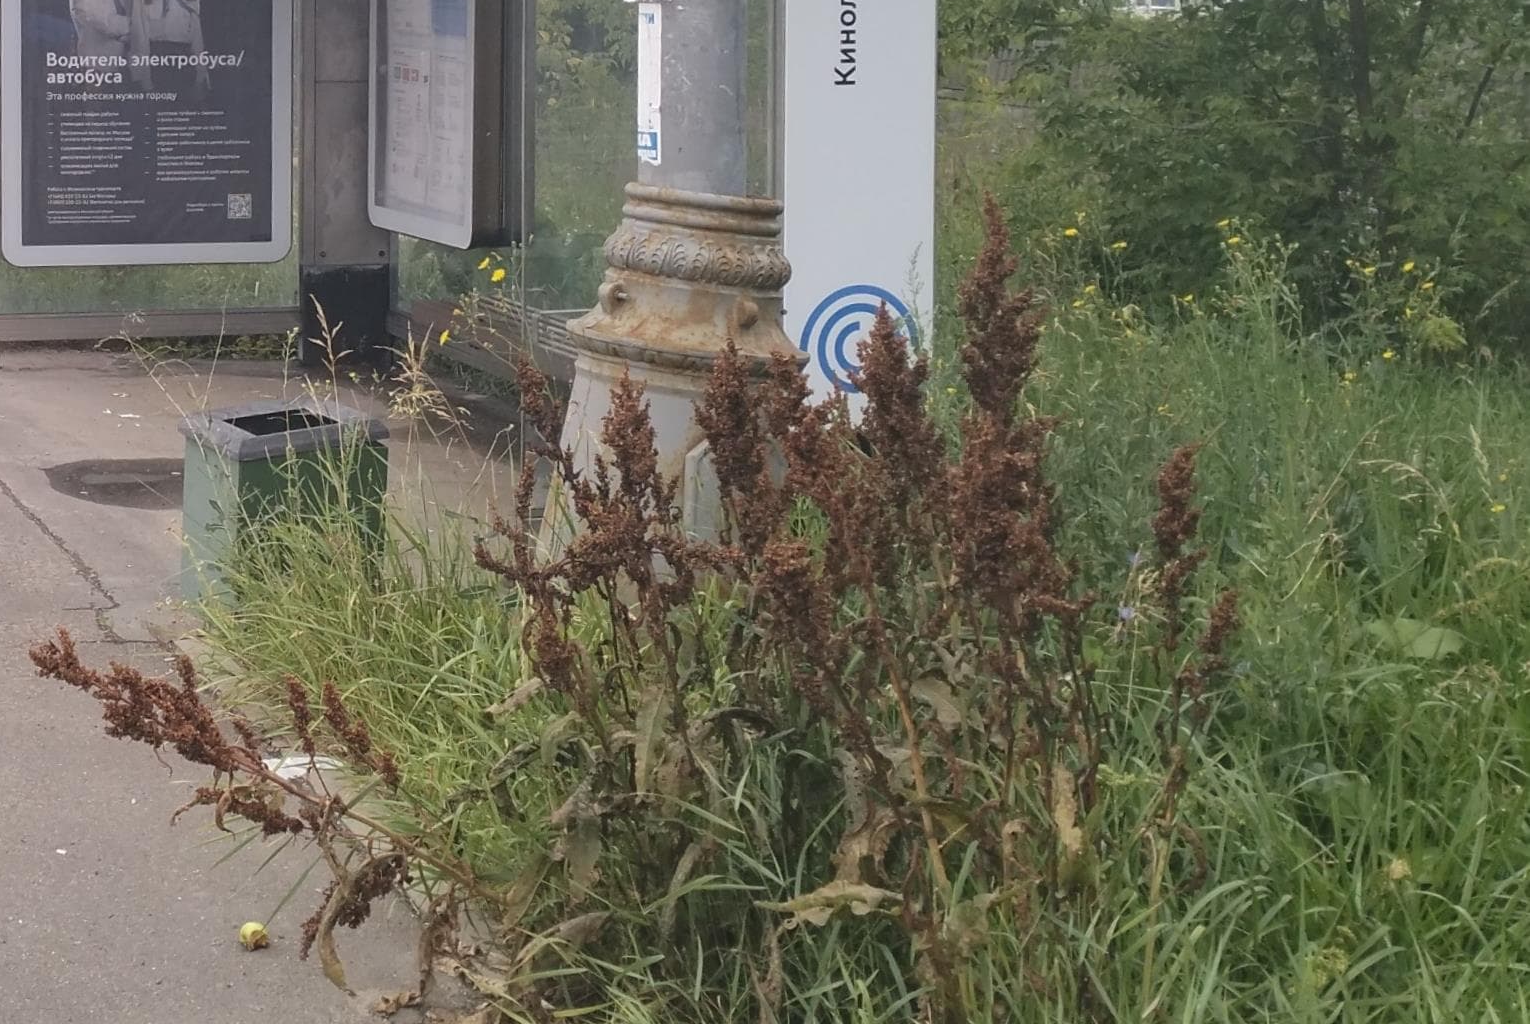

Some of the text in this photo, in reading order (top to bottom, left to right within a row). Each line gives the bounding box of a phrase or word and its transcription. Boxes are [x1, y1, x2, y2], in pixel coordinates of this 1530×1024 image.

[46, 49, 245, 70] Водитель электробуса/
[46, 69, 123, 87] автобуса
[45, 91, 178, 103] Эта профессия нужна городу
